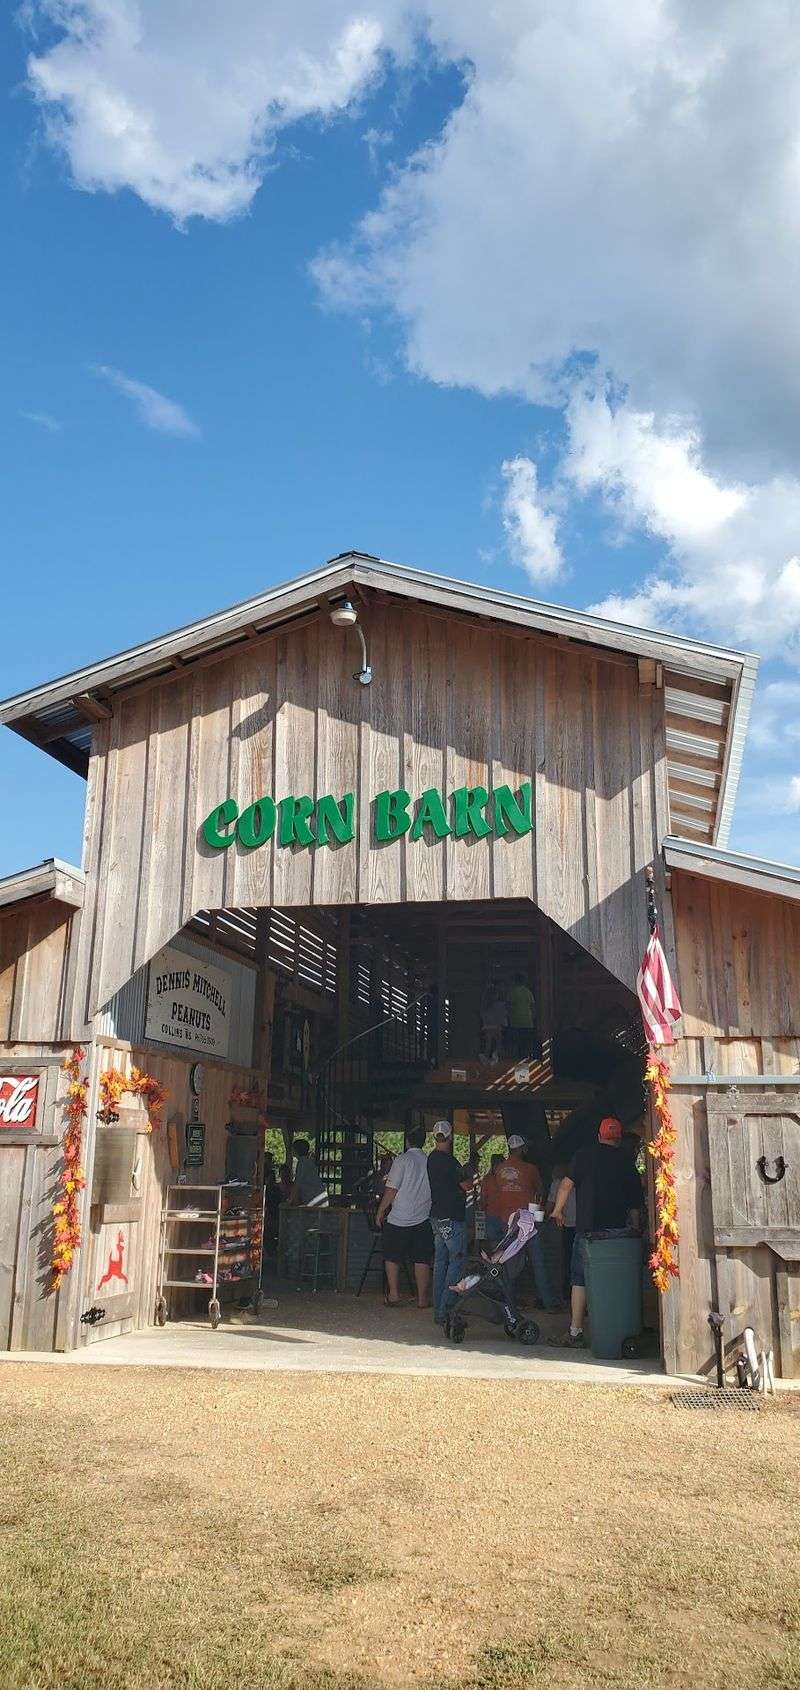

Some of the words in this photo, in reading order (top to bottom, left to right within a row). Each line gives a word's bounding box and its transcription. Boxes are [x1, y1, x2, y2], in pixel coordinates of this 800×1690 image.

[203, 792, 356, 849] CORN
[374, 782, 533, 842] BARN
[156, 968, 191, 995] DENNIS
[192, 973, 226, 1017] MITCHELL
[171, 1002, 211, 1032] PEANUTS
[0, 1077, 40, 1123] ola
